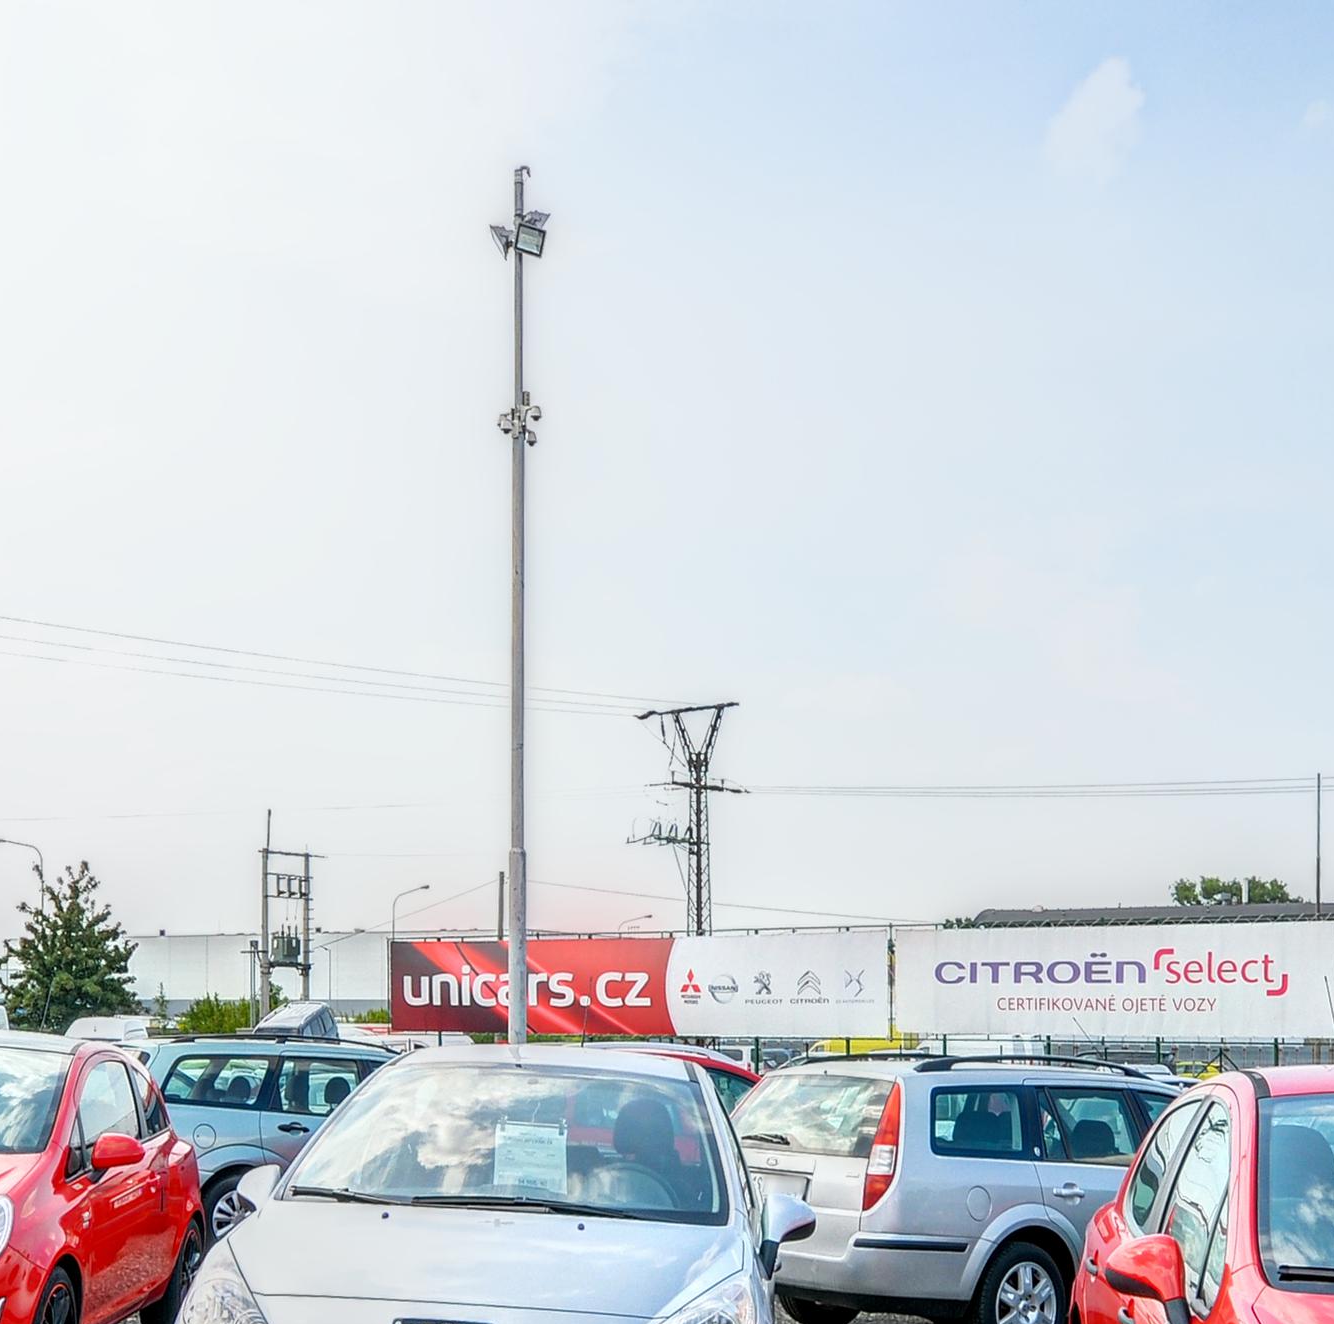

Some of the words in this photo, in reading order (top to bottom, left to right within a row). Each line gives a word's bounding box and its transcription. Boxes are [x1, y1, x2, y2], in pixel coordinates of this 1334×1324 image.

[934, 953, 1146, 984] CITROËN
[1166, 952, 1274, 984] select
[997, 995, 1116, 1012] CERTIFIKOVANÉ
[1122, 995, 1166, 1014] OJETÉ
[1172, 997, 1217, 1011] VOZY
